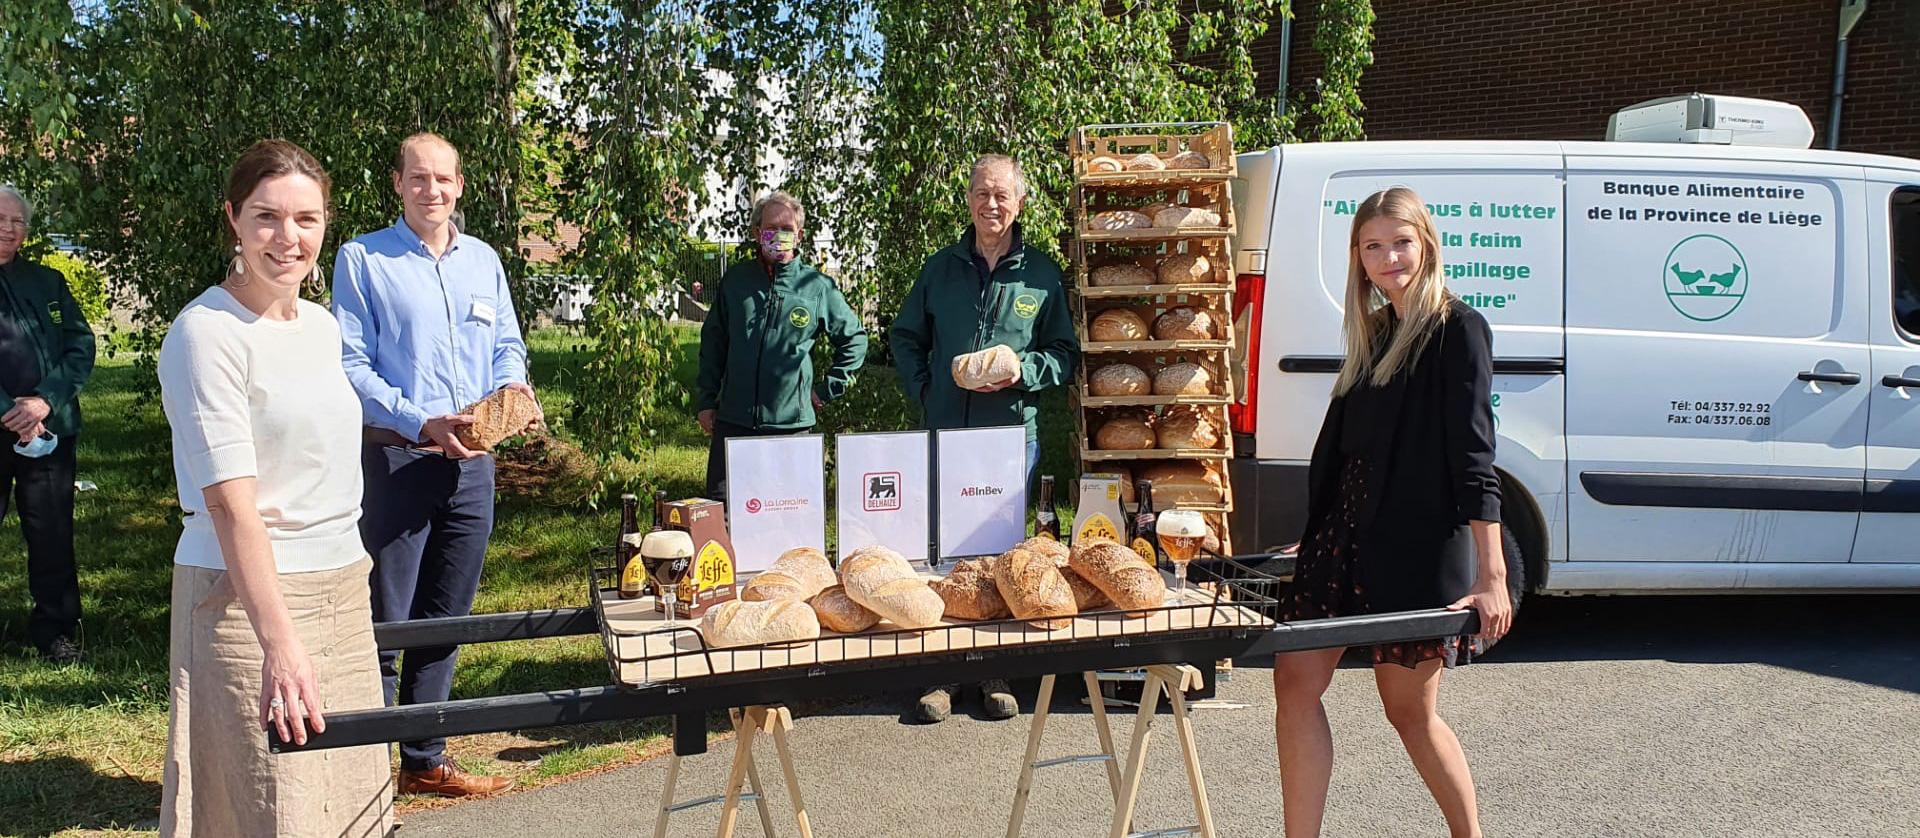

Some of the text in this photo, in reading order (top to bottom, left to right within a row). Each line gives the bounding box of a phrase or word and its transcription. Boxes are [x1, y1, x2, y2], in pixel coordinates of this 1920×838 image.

[1603, 181, 1805, 199] Banque Alimentaire
[1469, 201, 1483, 218] à
[1490, 203, 1556, 219] lutter
[1587, 206, 1822, 227] de la Province de Liège
[1442, 231, 1522, 248] la faim
[1443, 262, 1531, 280] spillage
[1461, 292, 1516, 309] aire"
[1670, 400, 1771, 413] Tél: 04/337.92.92
[1667, 414, 1771, 426] Fax: 04/337.06.08
[764, 497, 809, 507] La Lorraine
[867, 498, 897, 508] DELHAIZE
[671, 558, 689, 572] Leffe
[699, 556, 728, 584] Leffe
